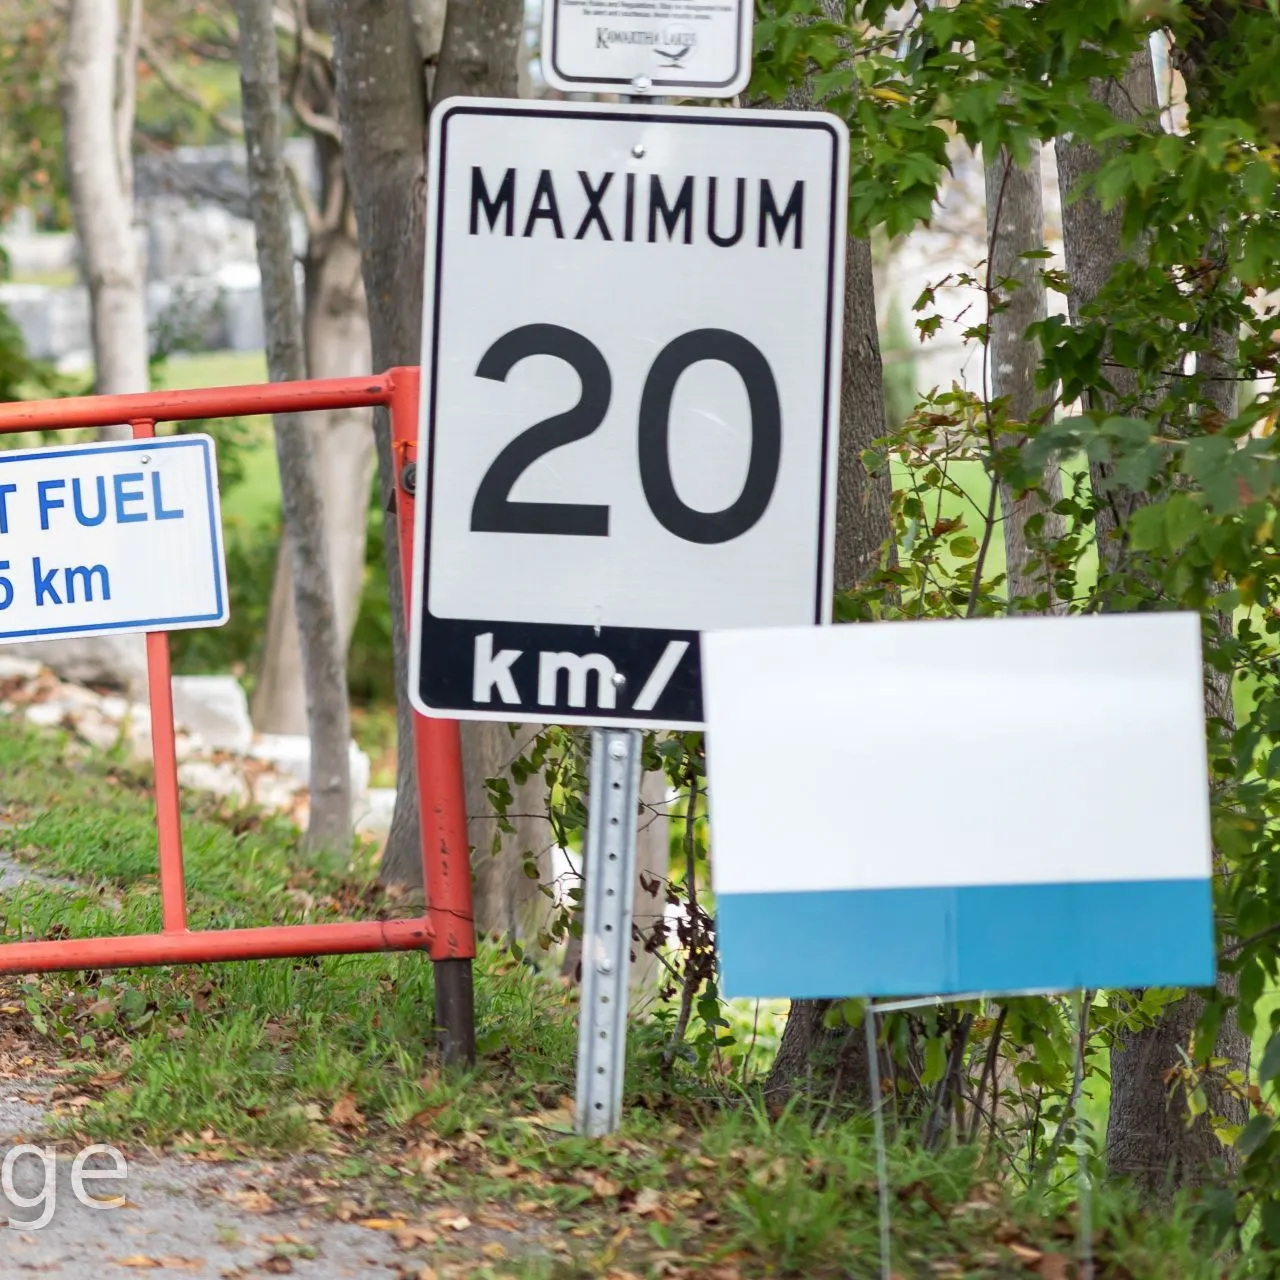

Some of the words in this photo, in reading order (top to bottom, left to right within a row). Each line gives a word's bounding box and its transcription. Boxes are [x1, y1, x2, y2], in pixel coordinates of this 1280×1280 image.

[469, 166, 805, 249] MAXIMUM
[470, 323, 783, 545] 20
[38, 471, 184, 530] FUEL
[32, 556, 112, 607] km
[472, 632, 690, 712] km/
